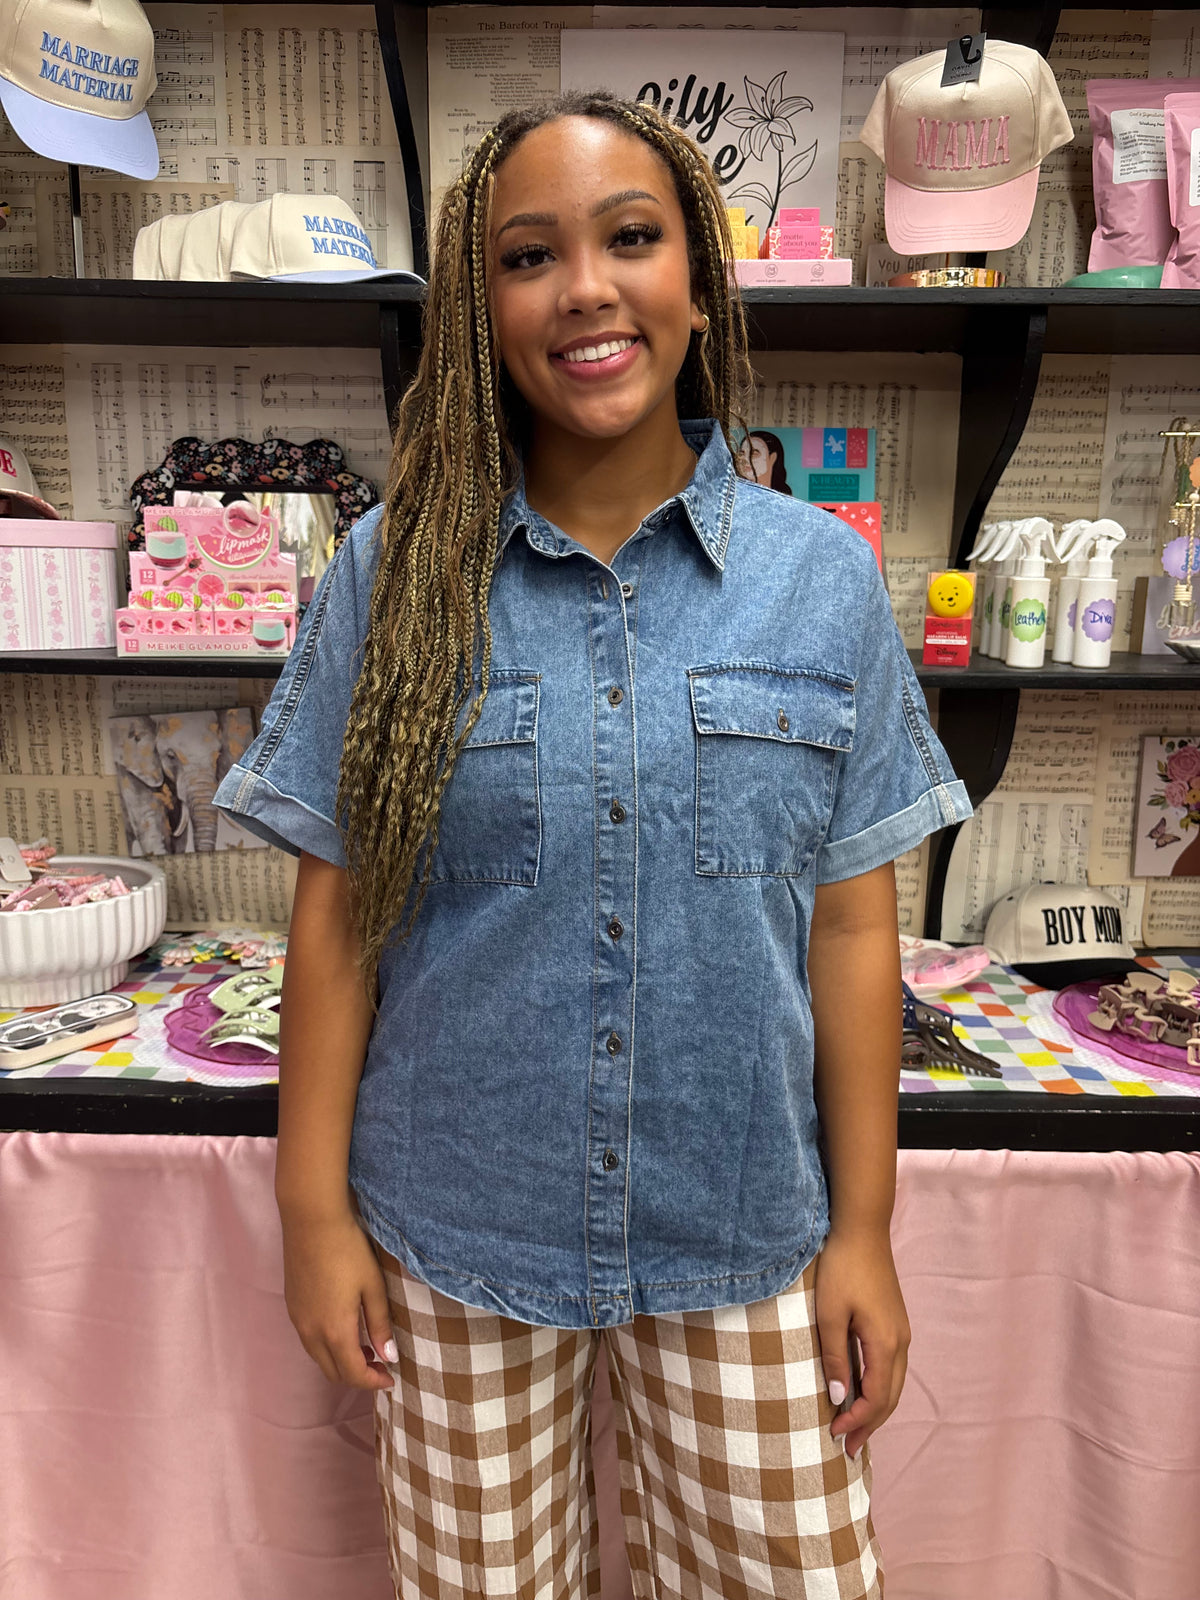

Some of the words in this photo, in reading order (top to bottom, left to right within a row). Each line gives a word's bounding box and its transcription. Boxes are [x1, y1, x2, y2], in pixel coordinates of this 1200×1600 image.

[477, 22, 495, 31] The
[499, 21, 539, 30] Barefoot
[40, 31, 139, 77] MARRIAGE
[39, 58, 134, 102] MATERIAL
[914, 115, 1010, 171] MAMA
[878, 259, 900, 273] YOU
[142, 570, 154, 579] 12
[1088, 610, 1113, 625] Diva
[127, 640, 137, 648] 12
[147, 643, 185, 651] MEIKE
[188, 643, 249, 651] GLAMOUR
[1041, 905, 1087, 946] BOY
[1090, 904, 1123, 945] MOM
